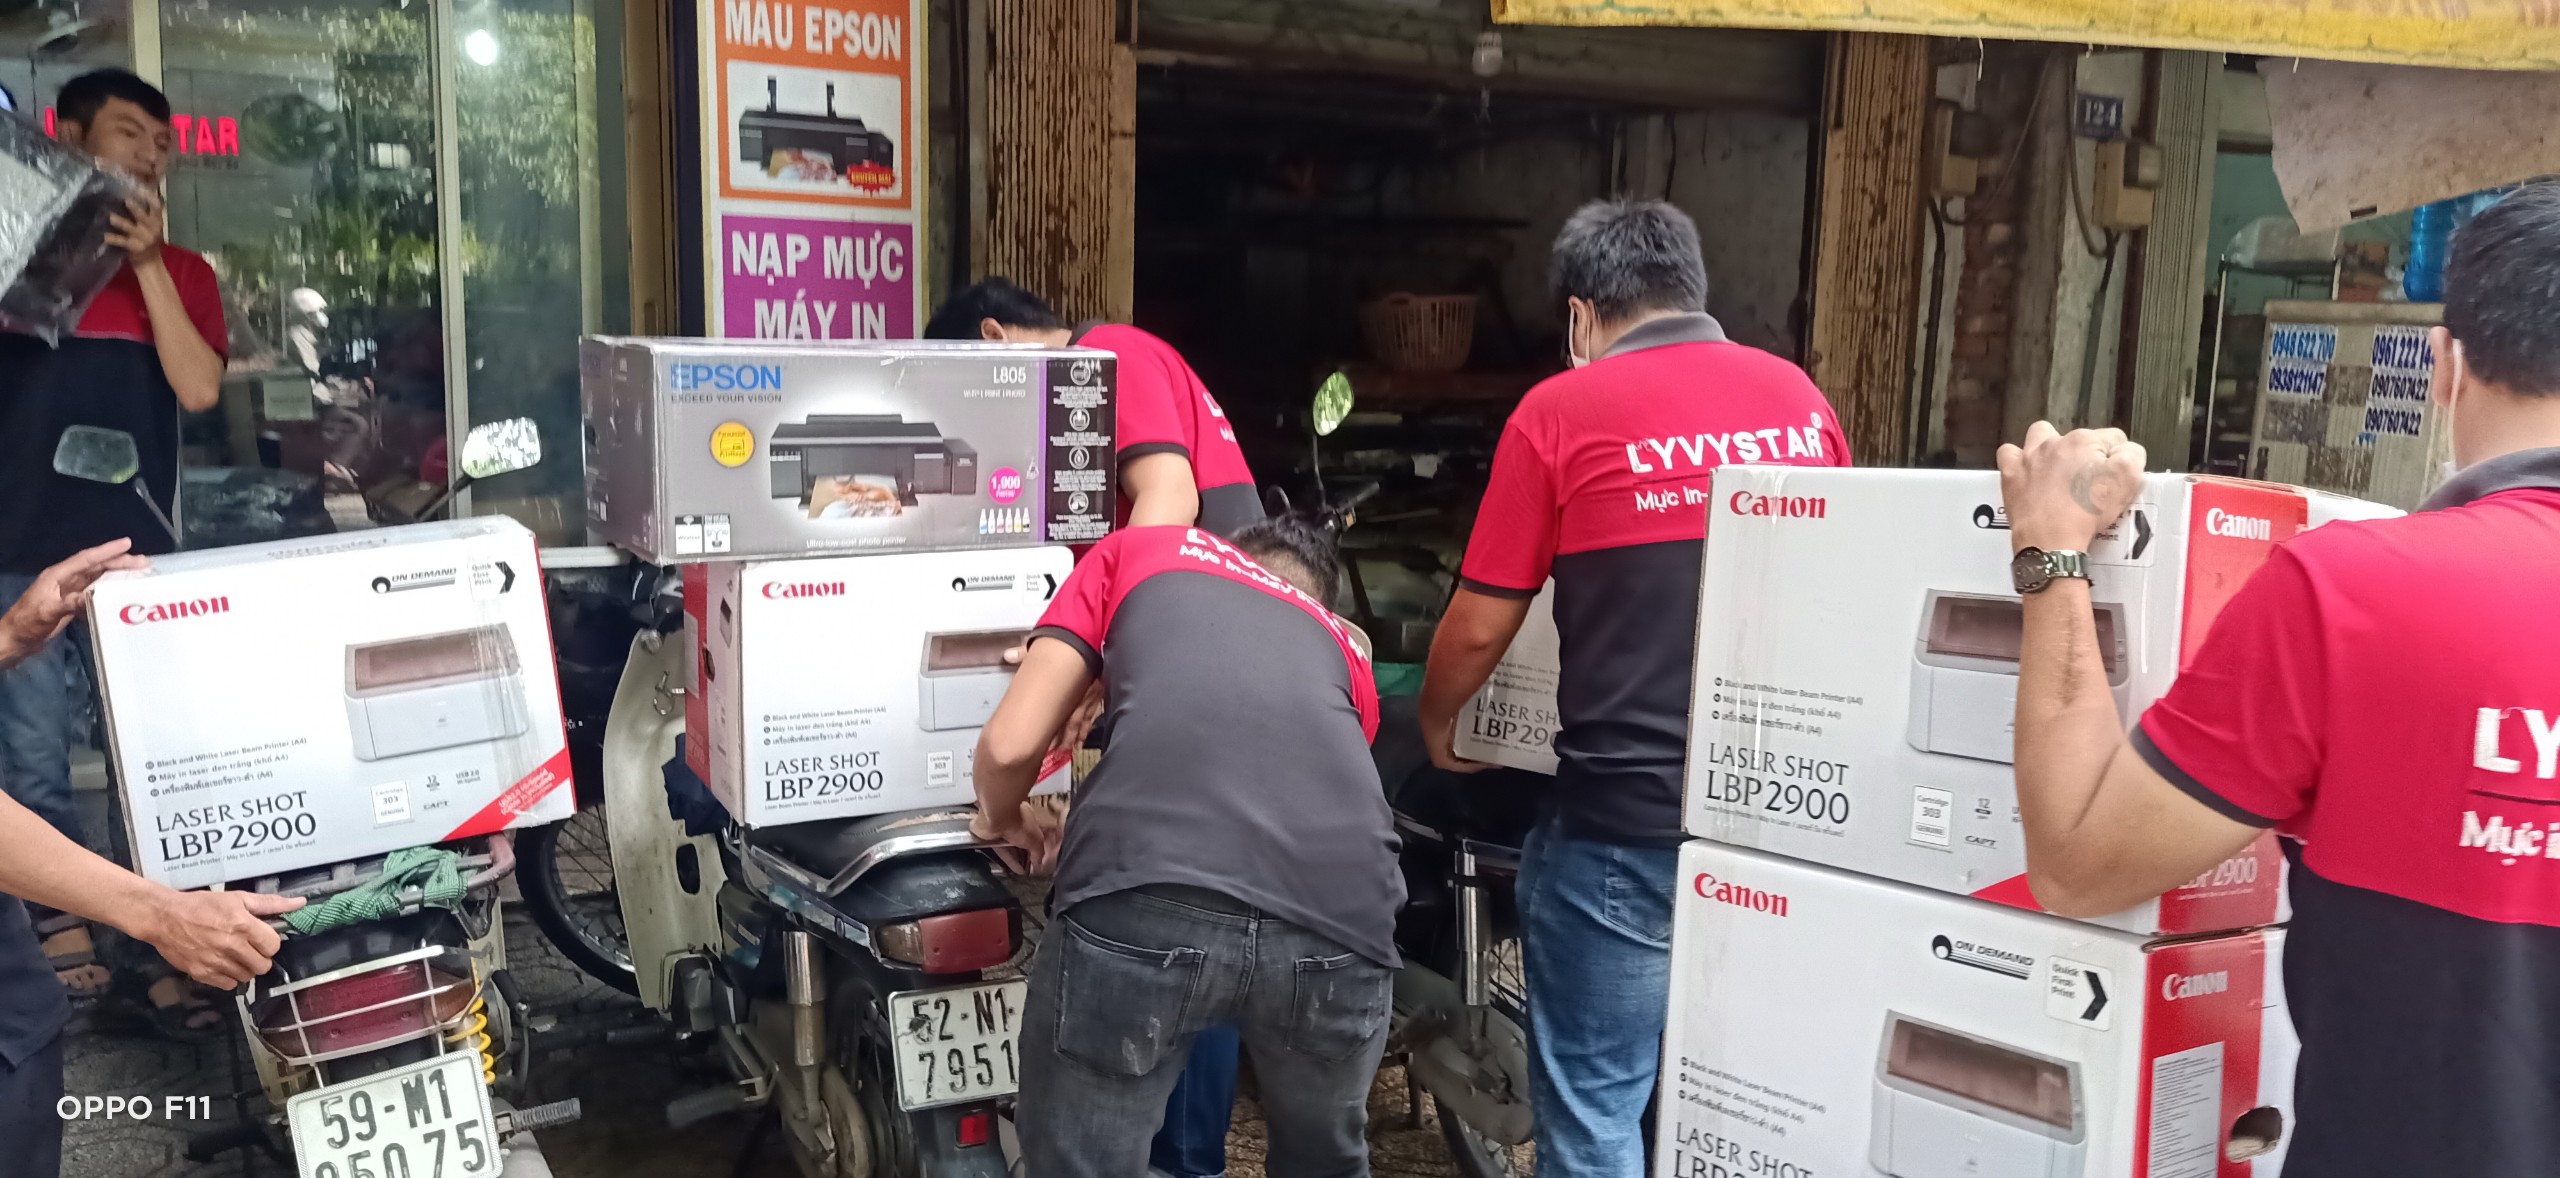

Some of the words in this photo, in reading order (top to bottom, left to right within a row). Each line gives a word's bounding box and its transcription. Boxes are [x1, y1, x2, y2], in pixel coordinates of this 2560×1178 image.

[805, 6, 900, 61] EPSON
[2085, 101, 2116, 127] 124
[732, 230, 810, 286] NẠP
[824, 229, 904, 290] MỰC
[755, 288, 837, 340] MÁY
[852, 301, 886, 340] IN
[2372, 334, 2397, 368] 0961
[2398, 335, 2419, 370] 222
[671, 364, 781, 391] EPSON
[993, 365, 1026, 384] L805
[671, 393, 713, 404] EXCEED
[717, 393, 744, 404] YOUR
[748, 393, 782, 404] VISION
[1626, 426, 1823, 473] LYVYSTAR
[1634, 488, 1680, 514] Mực
[1729, 490, 1826, 518] Canon
[2206, 507, 2271, 541] Canon
[858, 536, 881, 547] photo
[882, 535, 907, 547] printer
[391, 573, 408, 582] ON
[411, 567, 457, 581] DEMAND
[762, 581, 845, 600] Canon
[119, 596, 229, 625] Canon
[802, 711, 819, 719] White
[1476, 698, 1529, 721] LASER
[1534, 709, 1557, 726] SH
[1472, 715, 1517, 740] LBP
[1518, 724, 1556, 748] 29
[157, 757, 177, 768] Black
[179, 754, 193, 764] and
[195, 751, 218, 762] White
[220, 748, 239, 758] Laser
[264, 740, 289, 751] Printer
[291, 737, 307, 747] (A4)
[765, 757, 824, 776] LASER
[830, 751, 880, 771] SHOT
[1709, 742, 1777, 774] LASER
[1783, 755, 1849, 786] SHOT
[765, 777, 813, 801] LBP
[817, 770, 883, 796] 2900
[1706, 769, 1762, 806] LBP
[1764, 780, 1850, 824] 2900
[156, 804, 235, 833] LASER
[242, 790, 307, 818] SHOT
[1922, 806, 1941, 819] 303
[1978, 797, 1990, 809] 12
[160, 828, 223, 862] LBP
[228, 812, 316, 850] 2900
[1965, 835, 1997, 847] CAPT
[2458, 810, 2545, 866] Mực
[1694, 873, 1788, 917] Canon
[1954, 940, 1976, 952] ON
[1976, 945, 2035, 967] DEMAND
[2052, 963, 2079, 978] Quick
[2162, 970, 2228, 1001] Canon
[918, 1039, 1018, 1099] 7951
[320, 1068, 453, 1149] 59-M1
[1675, 1122, 1743, 1166] LASER
